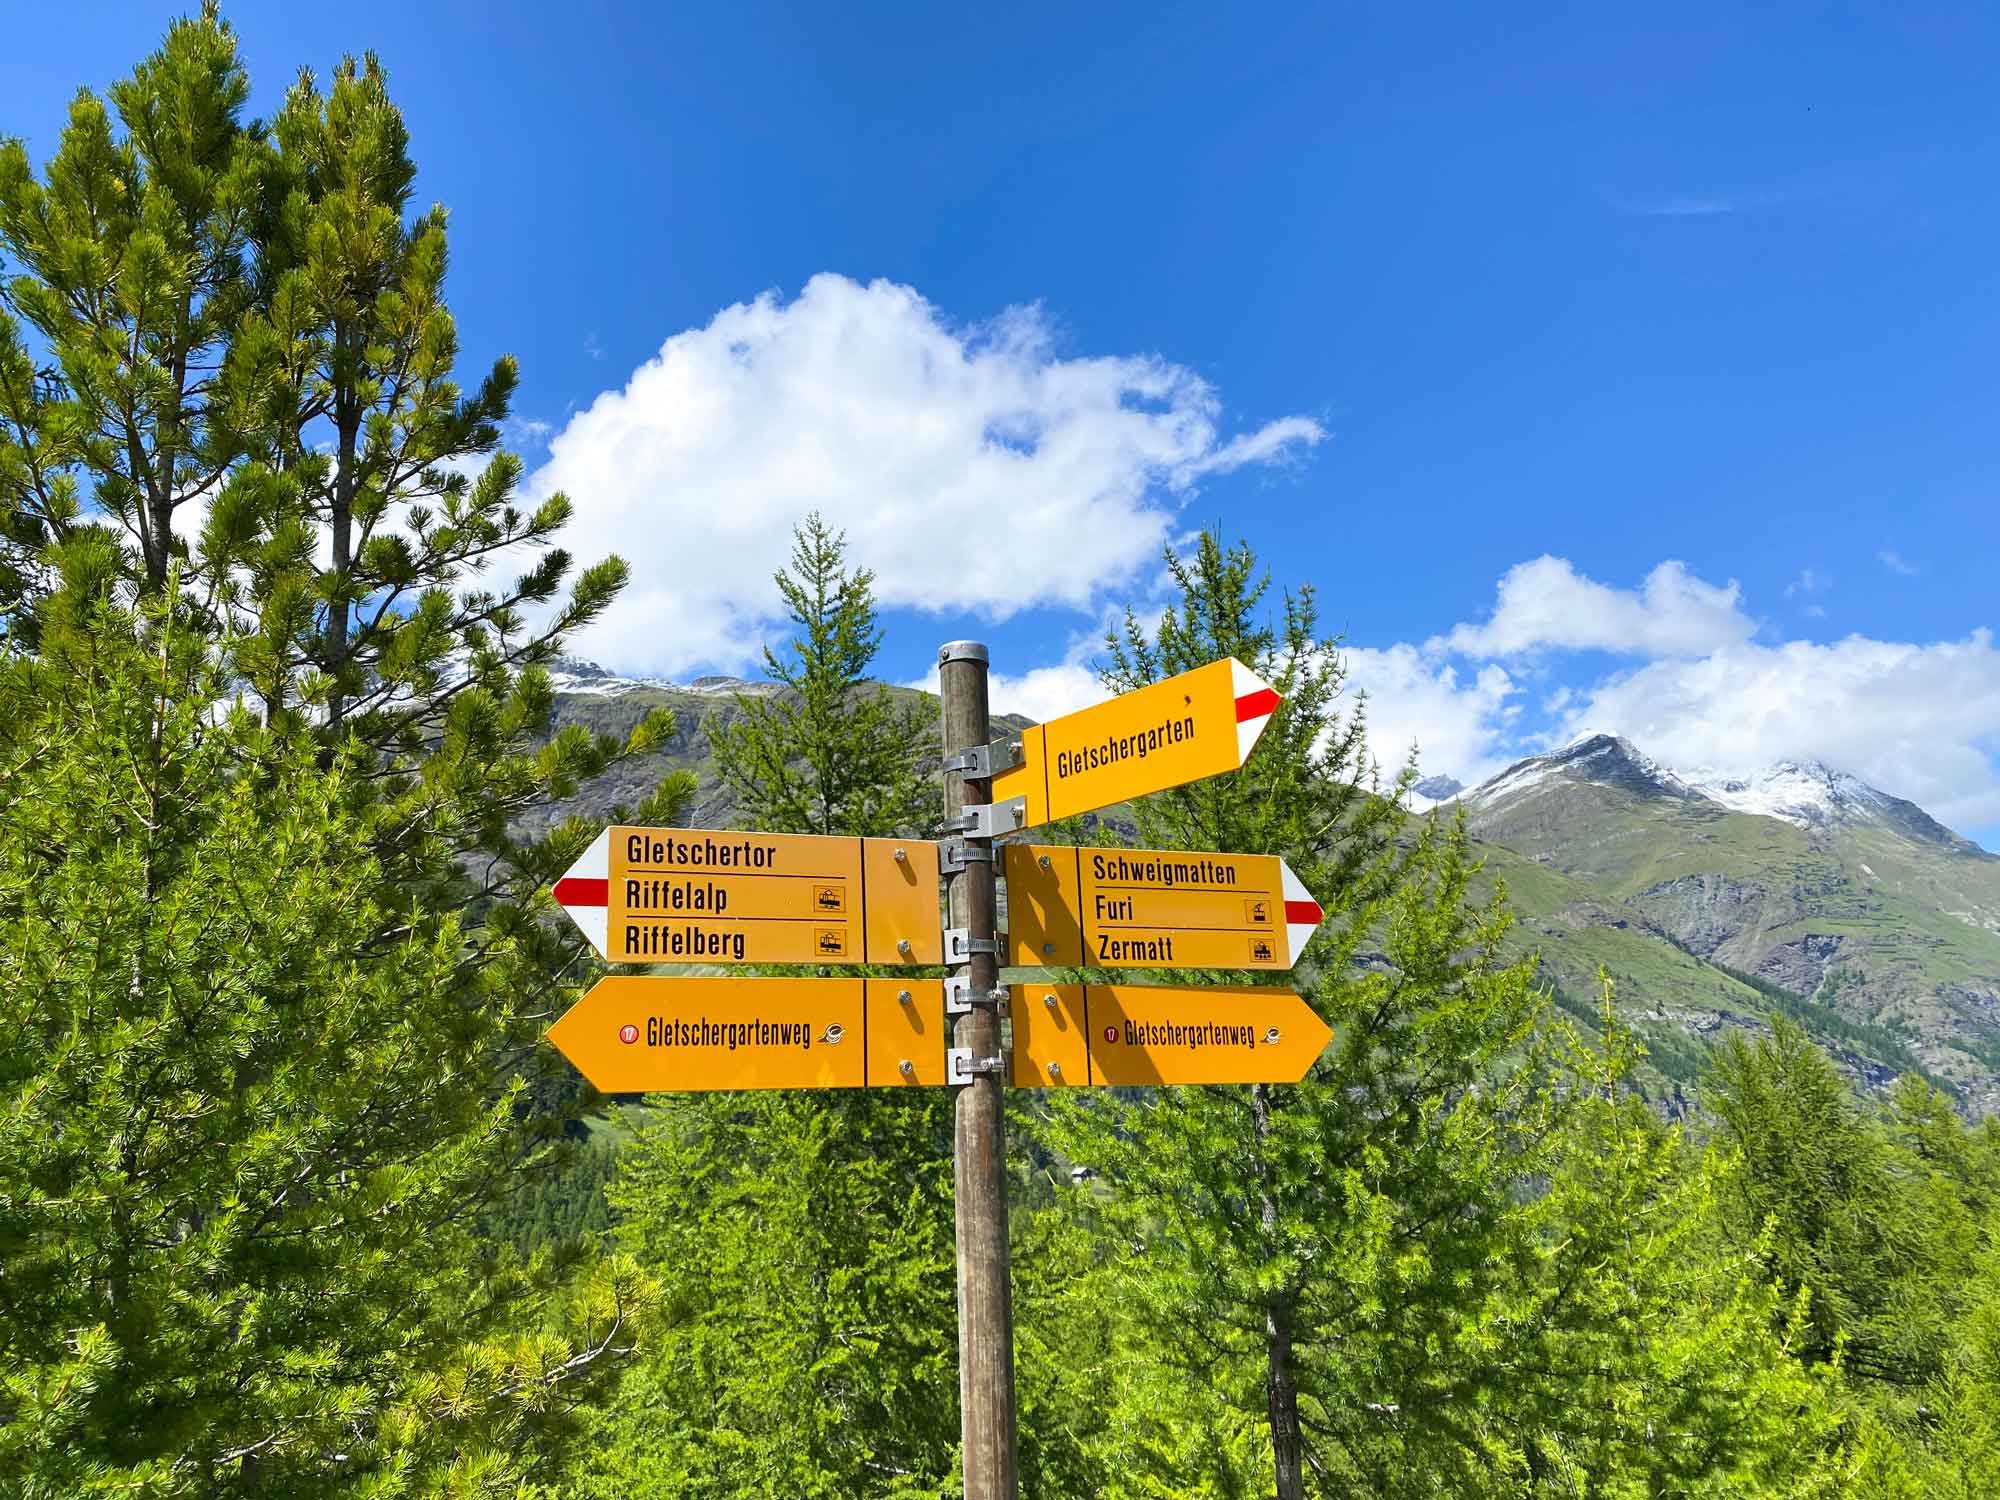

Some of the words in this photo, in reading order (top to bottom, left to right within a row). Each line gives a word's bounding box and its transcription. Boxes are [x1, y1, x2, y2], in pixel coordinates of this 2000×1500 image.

[1058, 715, 1195, 779] Gletschergarten
[627, 835, 776, 868] Gletschertor
[1093, 855, 1236, 886] Schweigmatten
[626, 880, 727, 914] Riffelalp
[1095, 895, 1134, 921] Furi
[625, 926, 745, 959] Riffelberg
[1098, 935, 1173, 961] Zermatt
[647, 1016, 811, 1050] Gletschergartenweg
[1124, 1020, 1255, 1049] Gletschergartenweg
